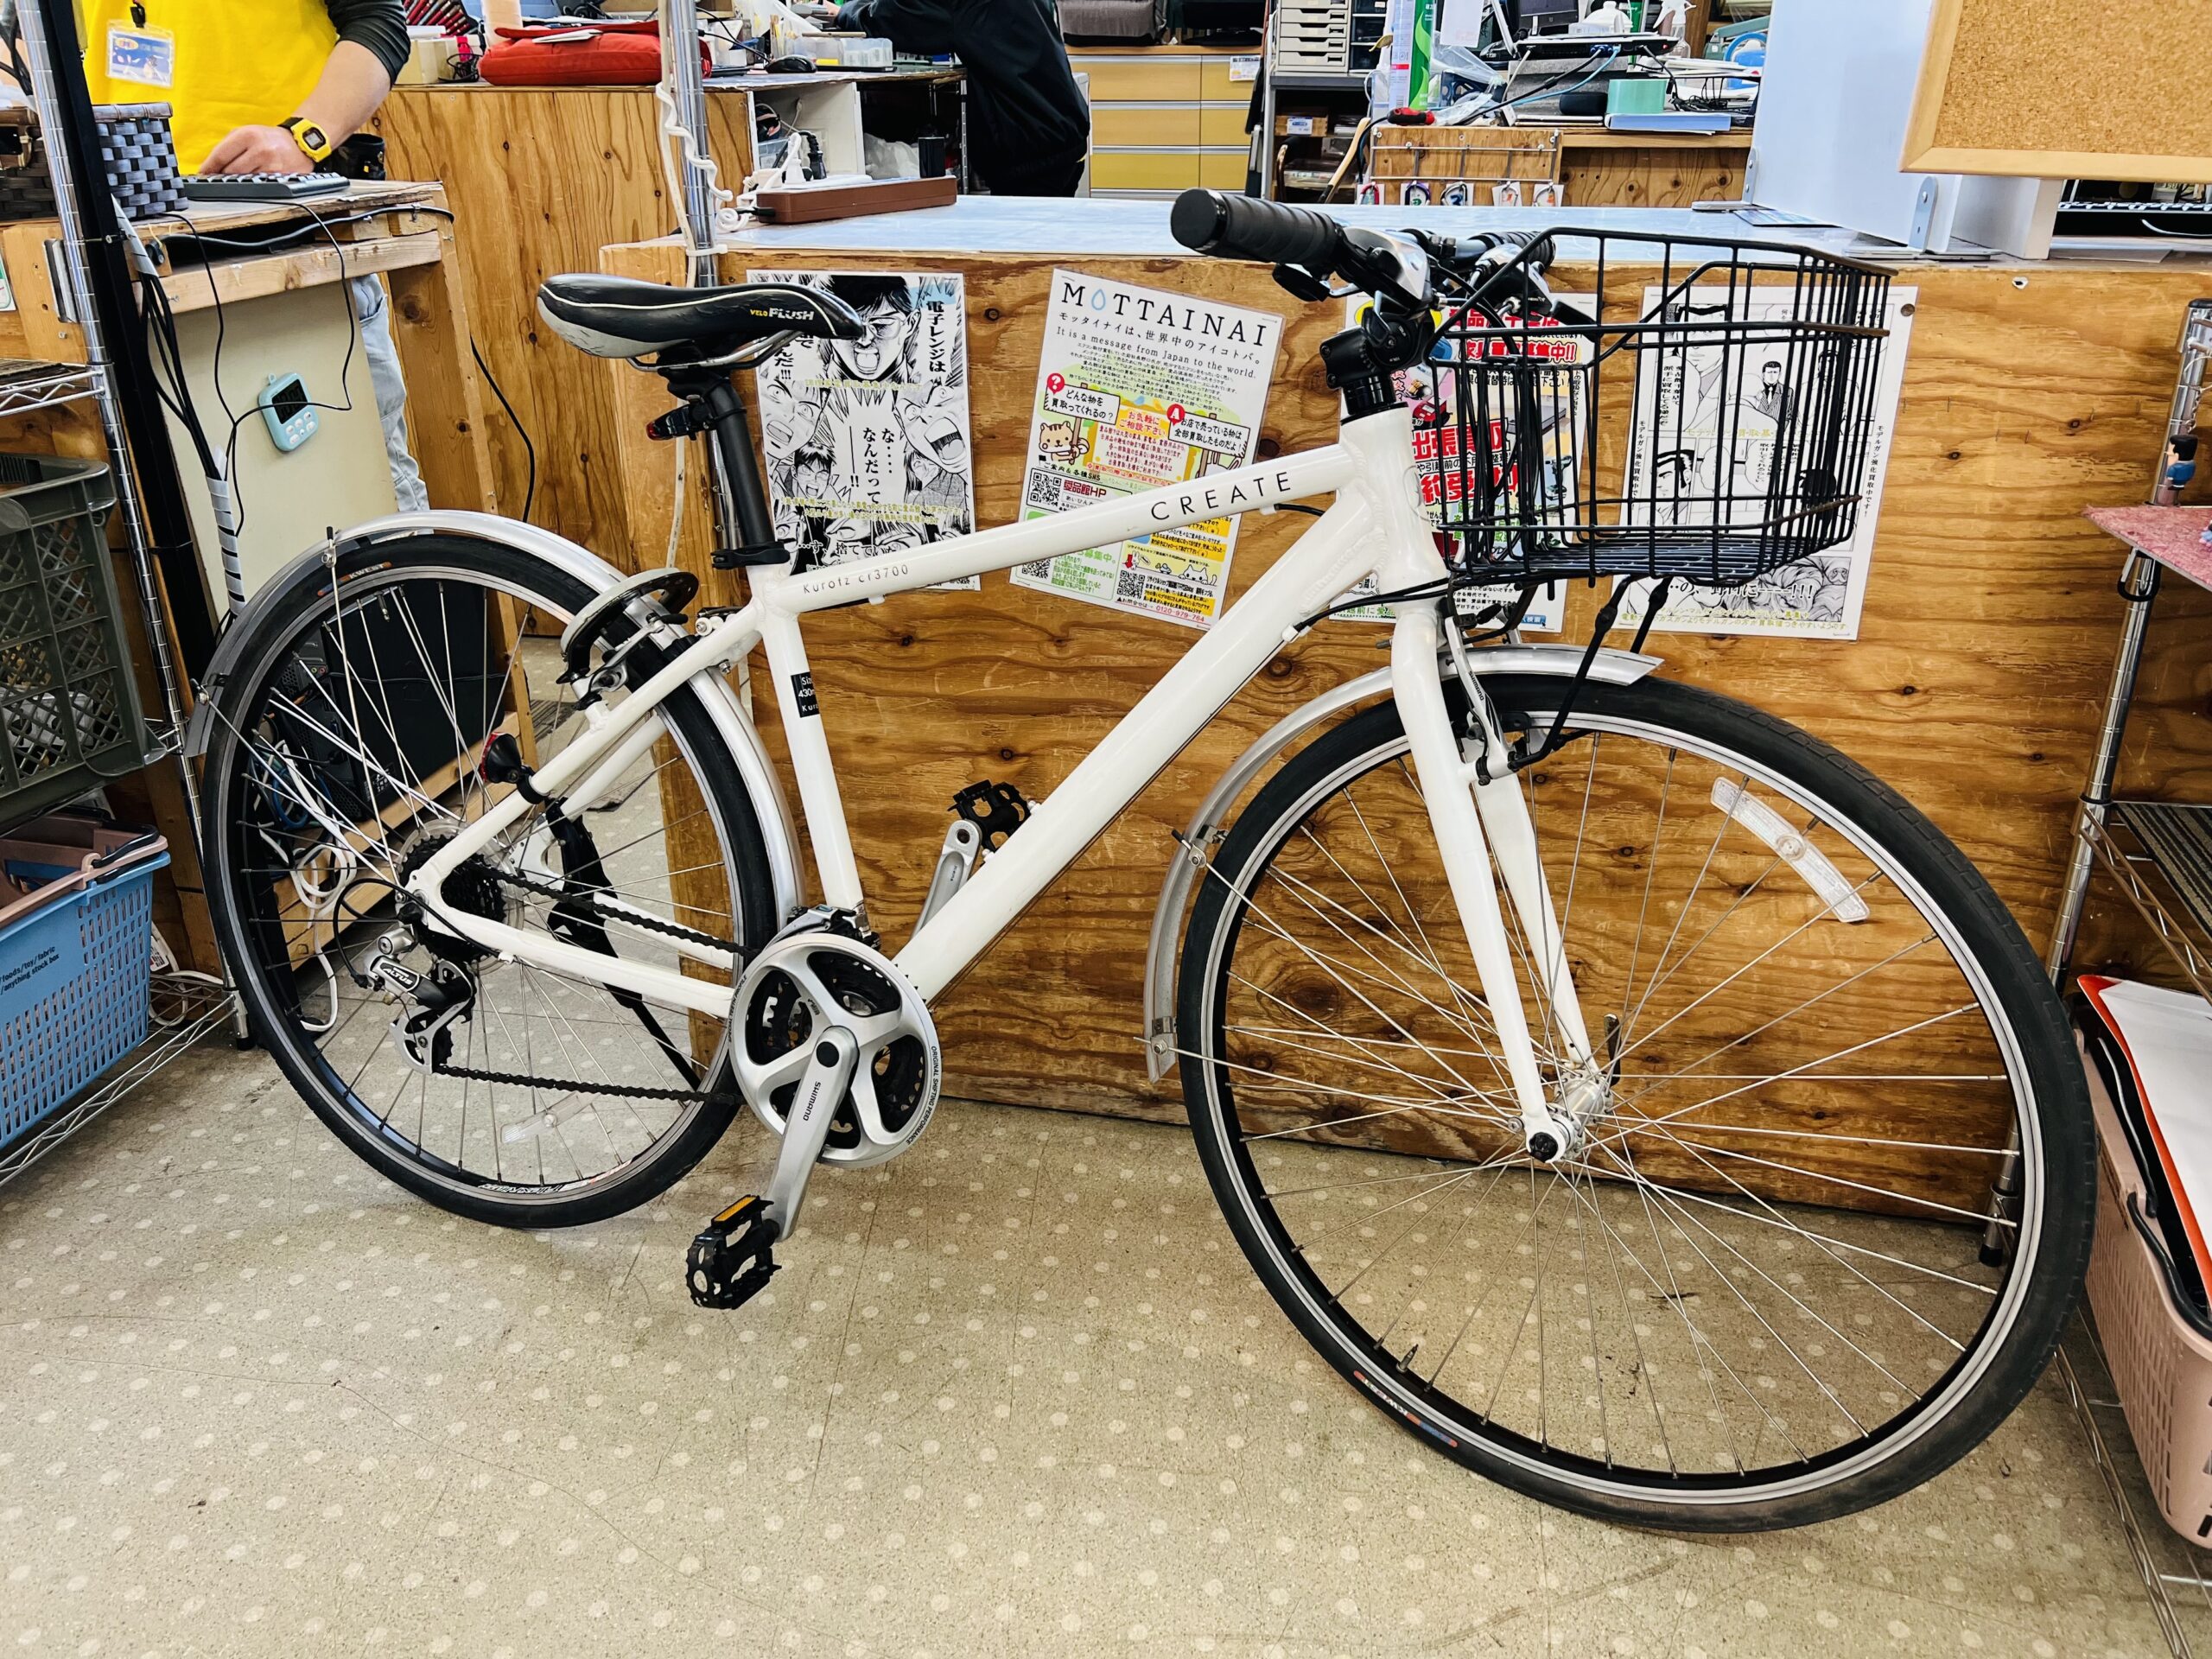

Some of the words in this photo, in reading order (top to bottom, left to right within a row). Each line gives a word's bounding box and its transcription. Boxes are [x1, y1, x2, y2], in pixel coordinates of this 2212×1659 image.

[750, 308, 768, 317] VELO
[769, 307, 815, 321] PLUSH
[926, 300, 946, 372] 電子レンジは
[1058, 310, 1262, 365] モッタイナイは、世界中のアイコトバ。
[1056, 327, 1065, 336] It
[1068, 329, 1077, 339] is
[1090, 336, 1132, 353] message
[1136, 344, 1159, 357] from
[1161, 349, 1189, 365] Japan
[1193, 357, 1204, 366] to
[1207, 359, 1223, 371] the
[1226, 364, 1257, 378] world.
[1065, 389, 1103, 406] どんな物を
[1119, 418, 1166, 437] ご相談下さい
[1128, 410, 1160, 425] お気軽に
[1180, 417, 1243, 440] お店で売っている物は
[862, 427, 881, 504] なんだって
[1063, 480, 1107, 499] 愛品館HP
[1151, 471, 1291, 521] CREATE
[347, 562, 385, 580] KWEST
[858, 564, 908, 583] cr3700
[32, 960, 48, 975] stock
[49, 953, 60, 964] box
[383, 967, 414, 986] ALTUS
[734, 974, 747, 998] PROFILE
[931, 1045, 939, 1077] ORIGINAL
[803, 1081, 822, 1122] SHIMANO
[928, 1078, 939, 1107] SHIFTING
[906, 1107, 933, 1146] PERFORMANCE
